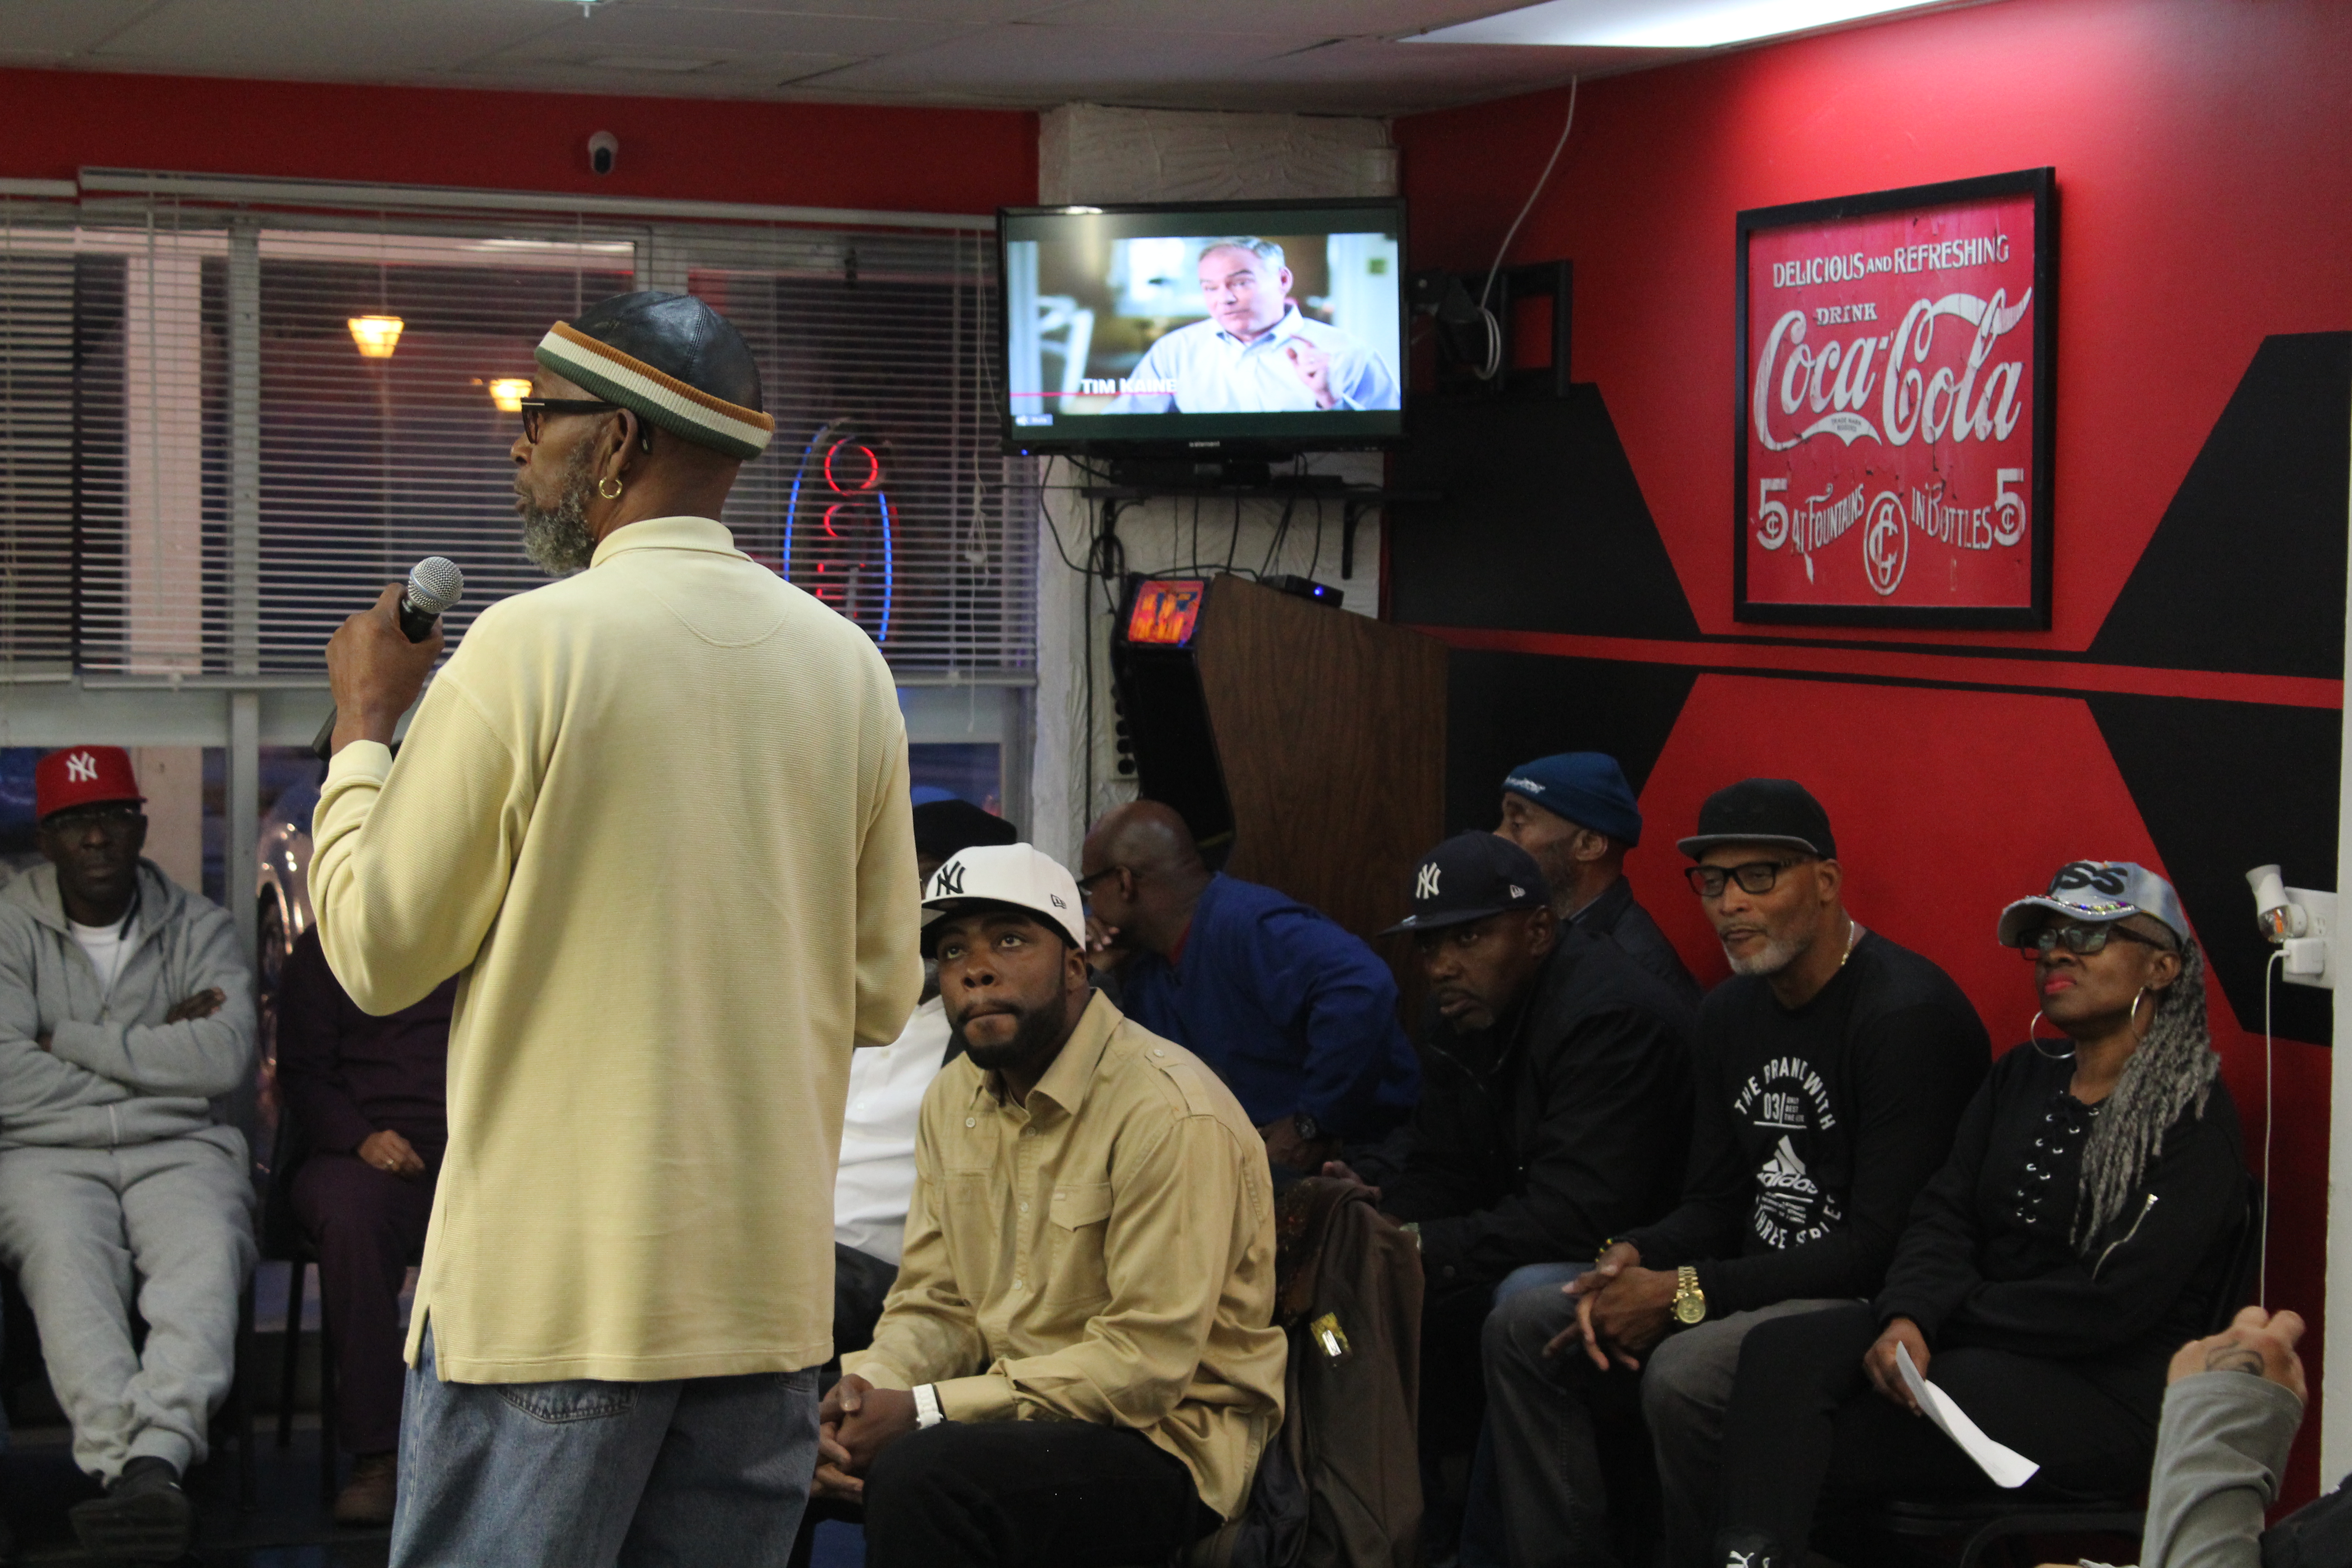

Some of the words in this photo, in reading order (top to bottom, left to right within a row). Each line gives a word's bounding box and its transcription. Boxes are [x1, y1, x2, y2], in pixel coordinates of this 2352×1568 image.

[1773, 252, 1865, 289] DELICIOUS
[1866, 255, 1892, 274] AND
[1893, 234, 2009, 274] REFRESHING
[1816, 302, 1878, 326] DRINK
[1081, 378, 1116, 394] TIM
[1119, 377, 1177, 393] KAINE
[1753, 286, 2032, 452] Coca-Cola
[1793, 508, 1808, 554] AT
[1804, 482, 1865, 569] FOUNTAINS
[1912, 486, 1926, 530] IN
[1925, 482, 1993, 550] BOTTLES
[66, 751, 98, 783] NY
[936, 860, 966, 897] NY
[1415, 862, 1441, 899] NY
[1734, 1075, 1762, 1115] THE
[1803, 1071, 1836, 1130] WITH
